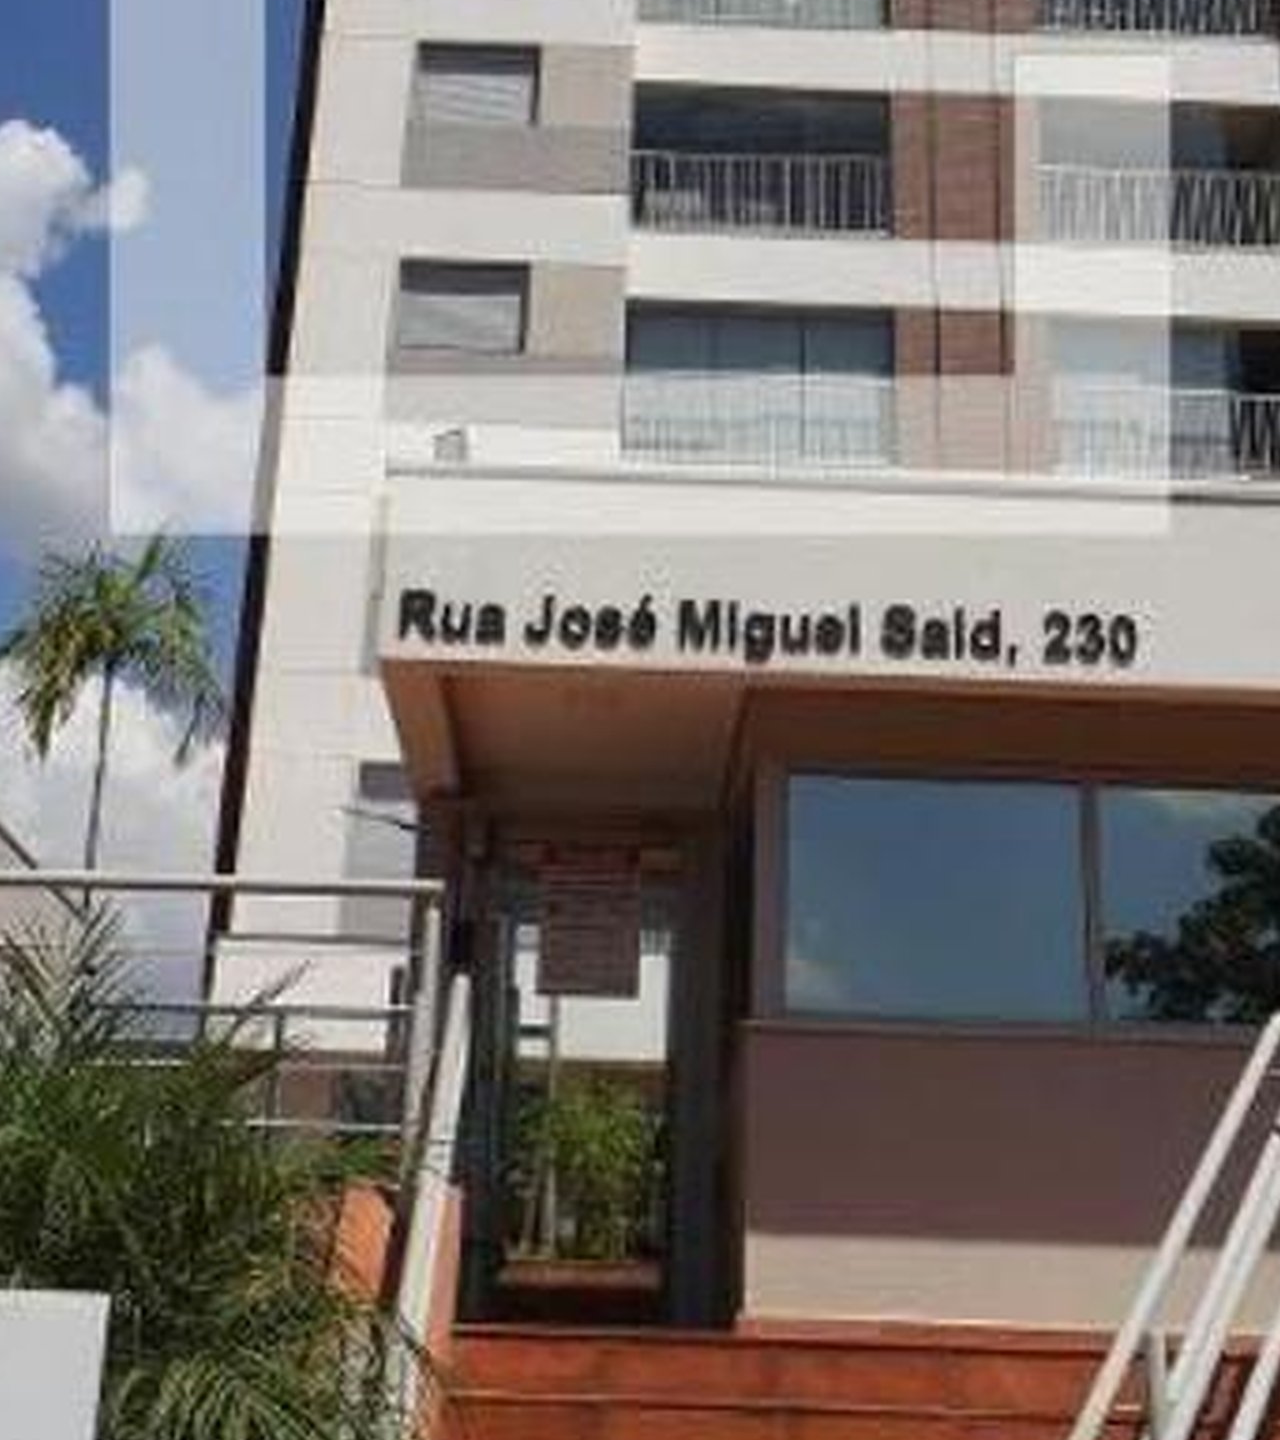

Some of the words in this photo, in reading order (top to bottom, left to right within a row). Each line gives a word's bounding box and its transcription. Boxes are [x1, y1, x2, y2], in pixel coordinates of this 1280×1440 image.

[398, 588, 505, 647] Rua
[523, 594, 657, 651] José
[677, 599, 862, 664] Miguel
[880, 603, 1019, 667] Said,
[1043, 609, 1139, 667] 230
